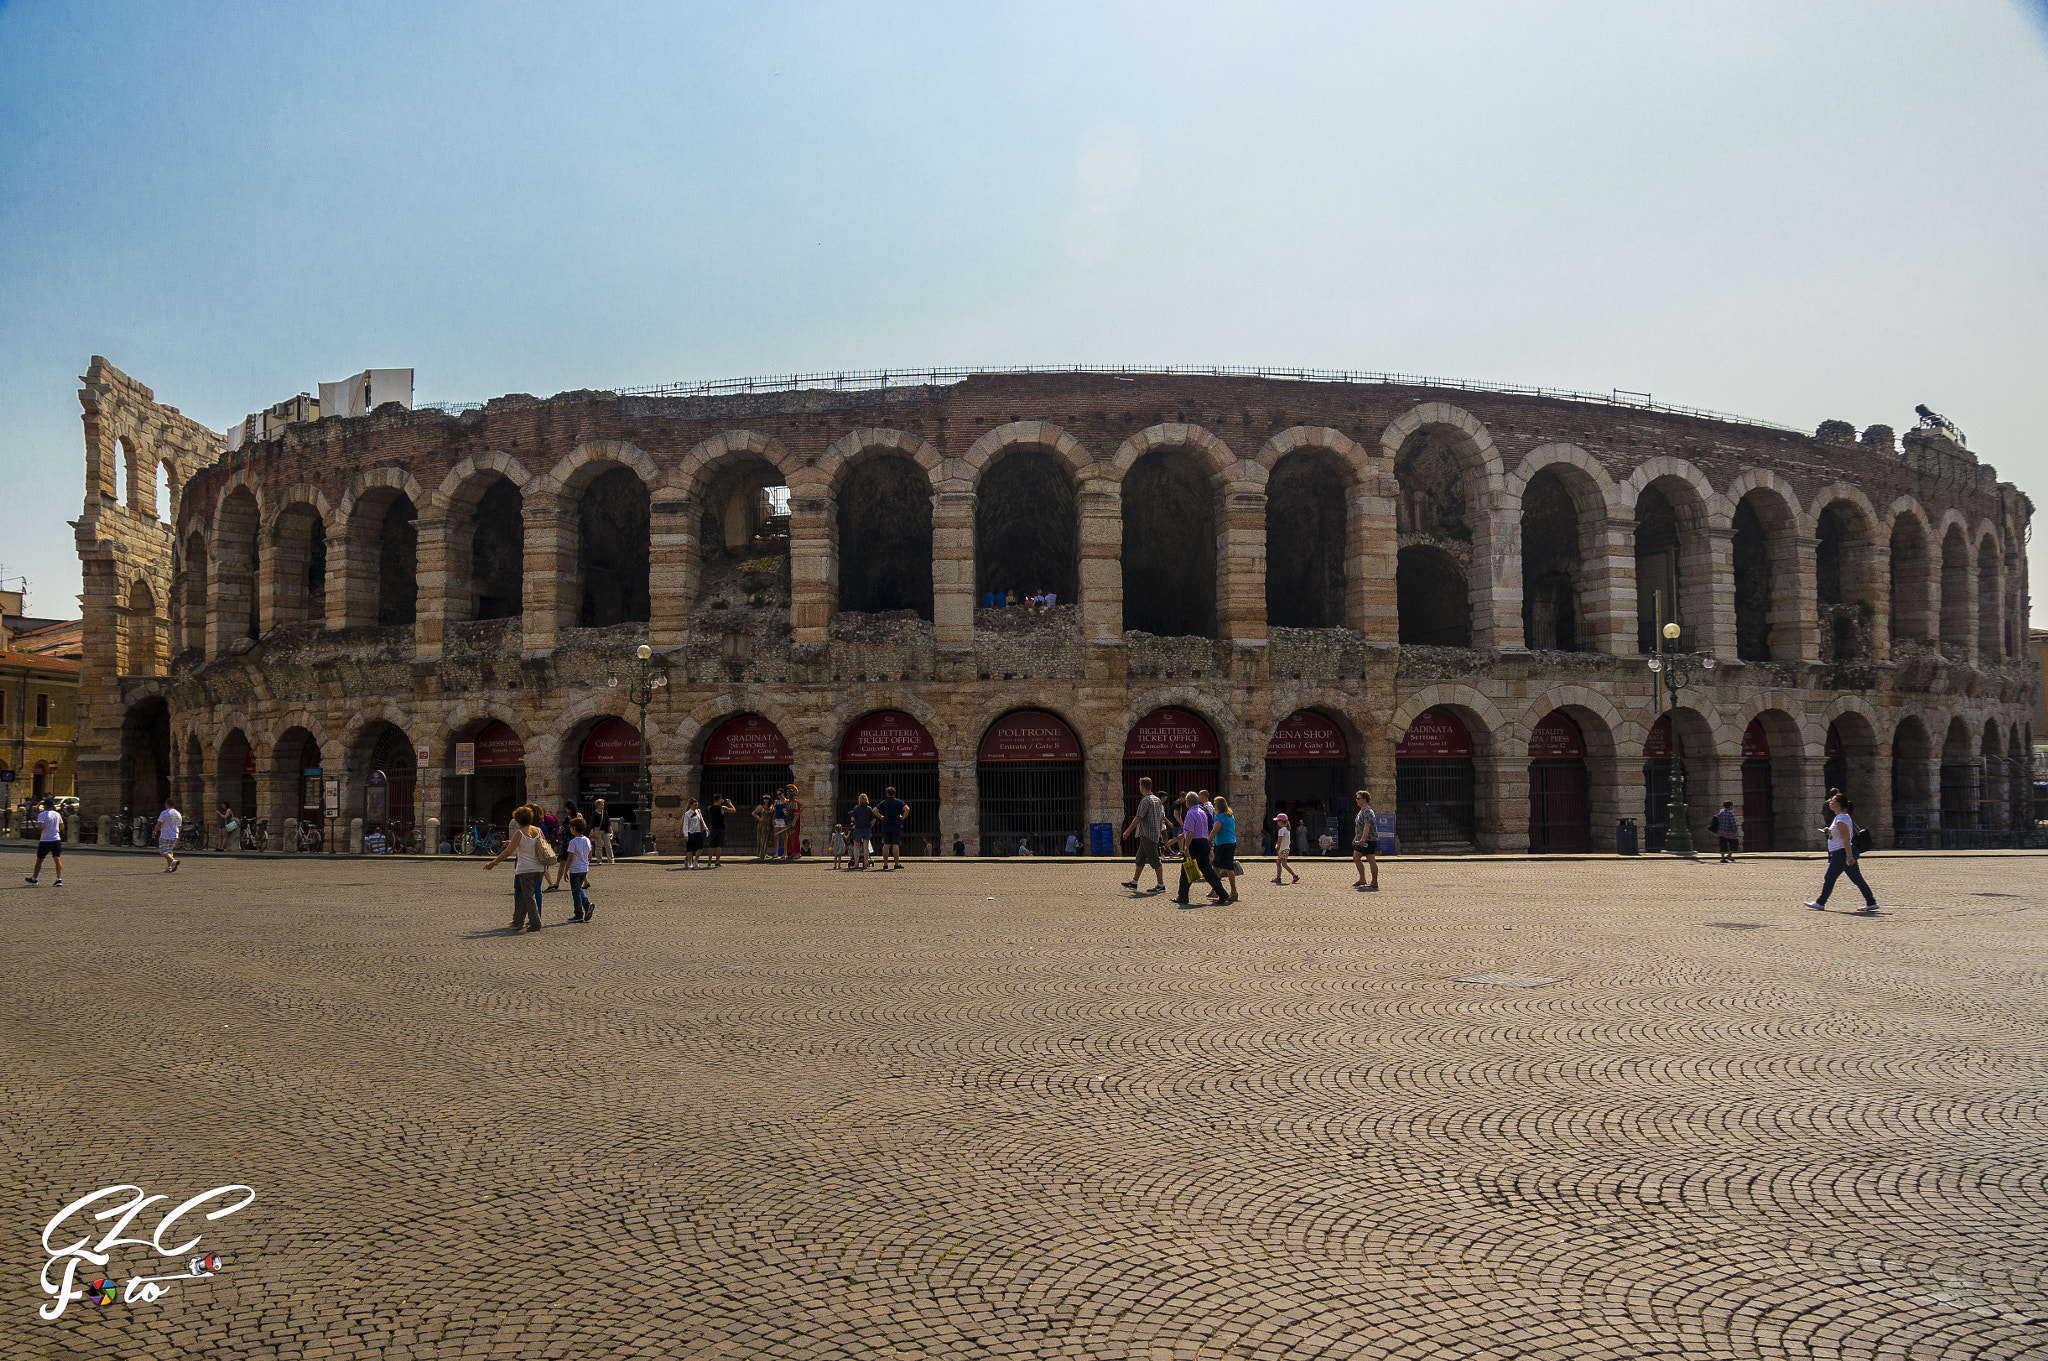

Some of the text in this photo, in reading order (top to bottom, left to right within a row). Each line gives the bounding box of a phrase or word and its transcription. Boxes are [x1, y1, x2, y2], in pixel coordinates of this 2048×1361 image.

[998, 728, 1061, 737] POLTRONE
[1303, 729, 1333, 739] SHOP
[726, 734, 779, 742] GRADINATA
[595, 740, 623, 748] Cancello
[628, 740, 640, 748] Gat
[1267, 741, 1296, 749] ancello
[1304, 741, 1323, 749] Gate
